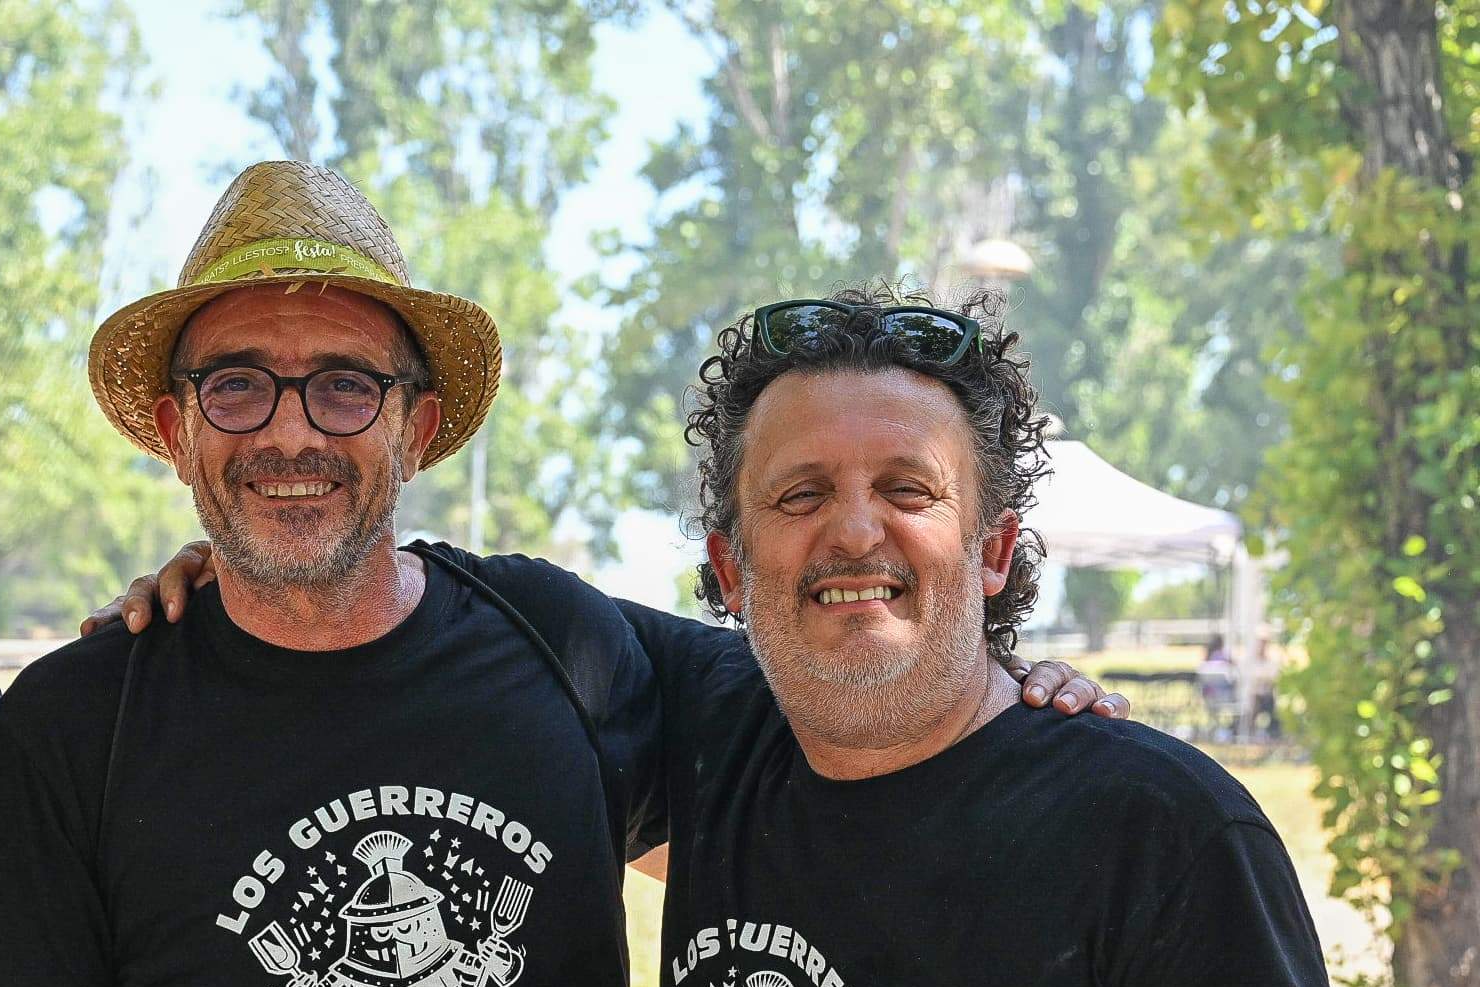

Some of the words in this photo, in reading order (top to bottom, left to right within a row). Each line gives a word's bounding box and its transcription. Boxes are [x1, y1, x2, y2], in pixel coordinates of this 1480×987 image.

[232, 246, 290, 265] LLESTOS?
[295, 240, 336, 261] festa!
[215, 850, 286, 934] LOS
[289, 785, 554, 874] GUERREROS
[672, 927, 720, 986] LOS
